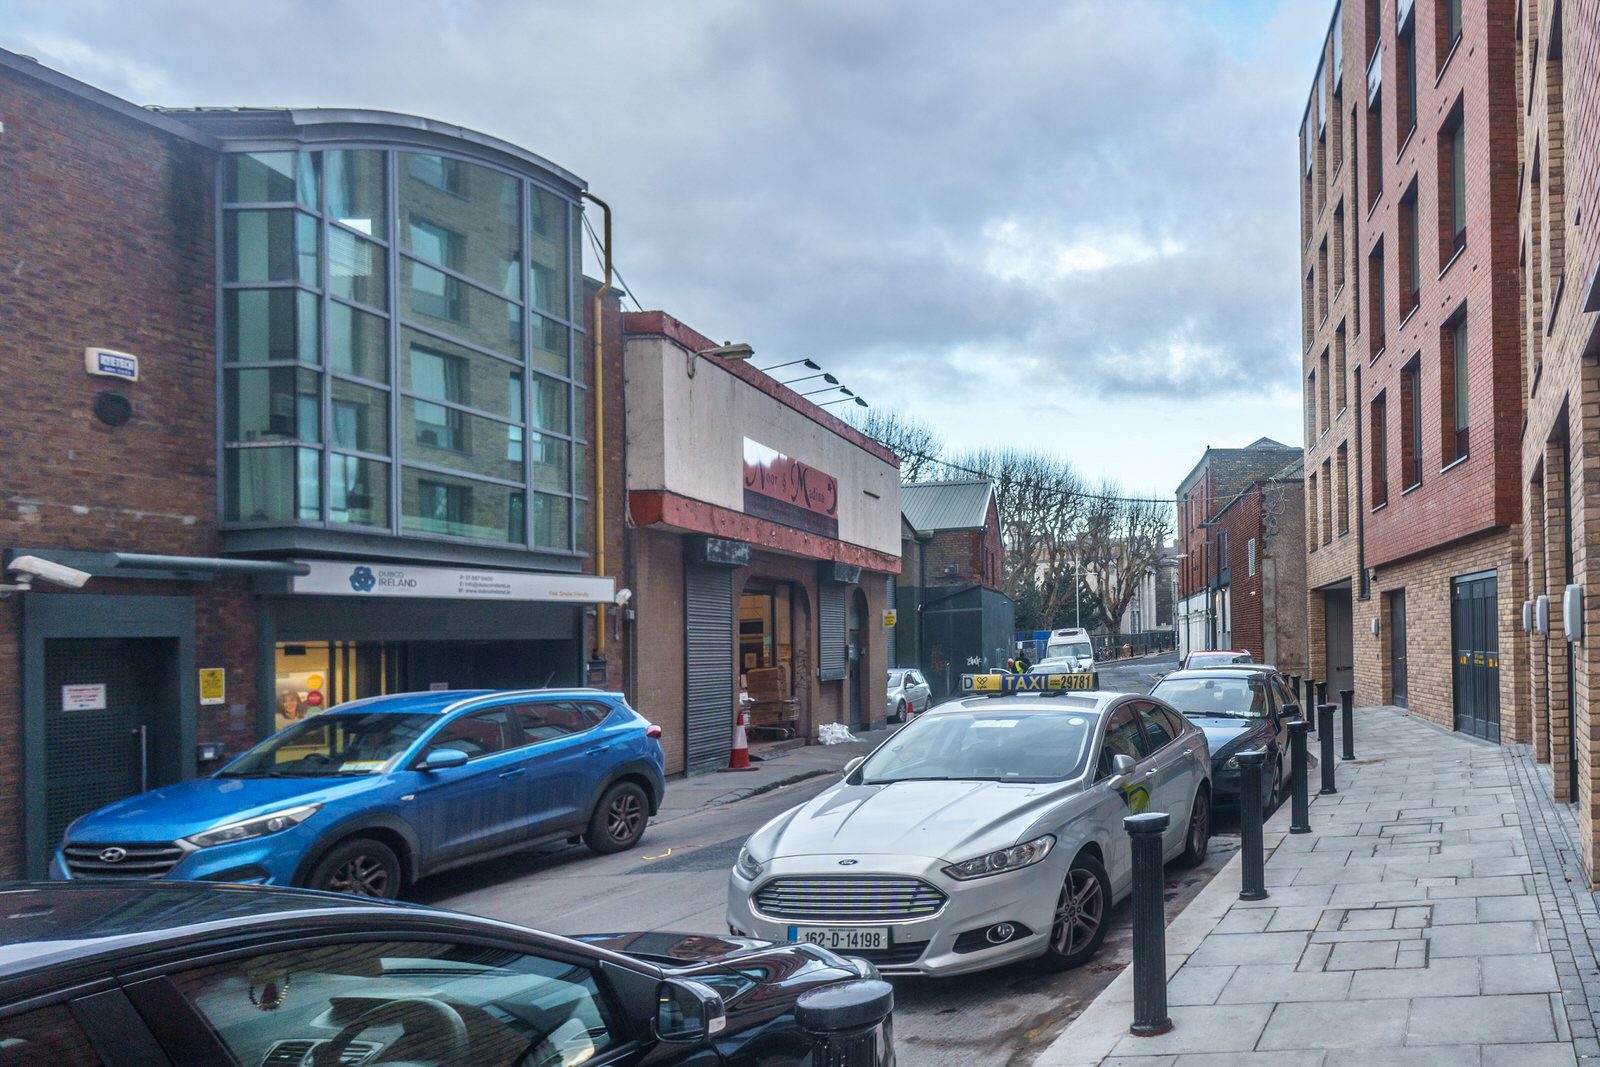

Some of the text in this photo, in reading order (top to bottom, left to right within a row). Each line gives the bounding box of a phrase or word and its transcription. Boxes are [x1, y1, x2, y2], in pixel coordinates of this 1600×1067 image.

[378, 577, 417, 588] IRELAND
[963, 677, 973, 689] D
[1005, 676, 1045, 690] TAXI
[1060, 675, 1090, 689] 29781
[805, 932, 880, 948] 162-D-14198
